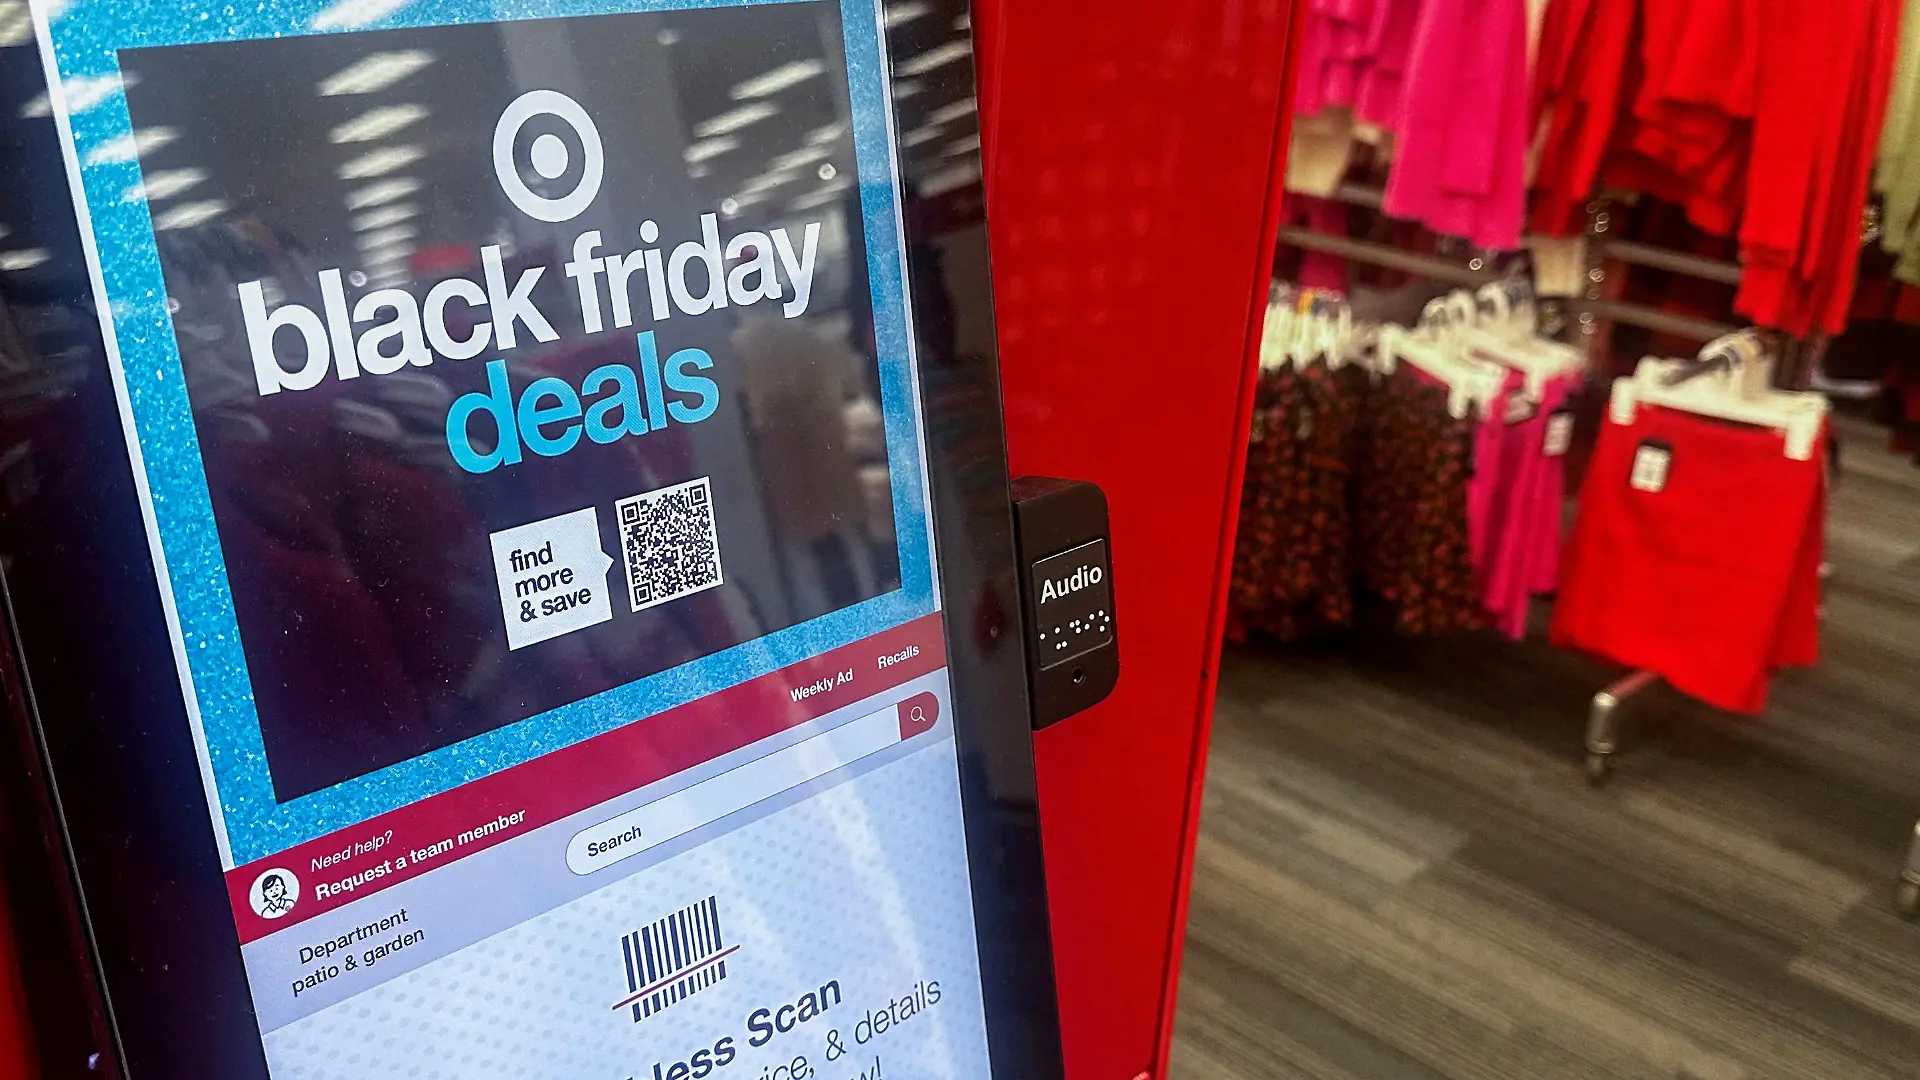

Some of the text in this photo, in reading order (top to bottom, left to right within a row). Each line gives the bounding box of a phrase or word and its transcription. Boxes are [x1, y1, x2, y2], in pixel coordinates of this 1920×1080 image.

[237, 213, 821, 396] black friday
[445, 330, 720, 474] deals
[509, 541, 553, 572] find
[515, 567, 573, 598] more
[1040, 565, 1102, 604] Audio
[520, 588, 591, 622] & save
[877, 645, 920, 669] Recalls
[789, 667, 854, 702] Weekly Ad
[311, 829, 393, 872] Need help?
[315, 809, 526, 901] Request a team member
[587, 826, 642, 857] Search
[299, 908, 409, 964] Department
[292, 928, 425, 998] patio & garden
[747, 979, 842, 1048] Scan
[826, 1029, 847, 1062] &
[855, 979, 942, 1045] details
